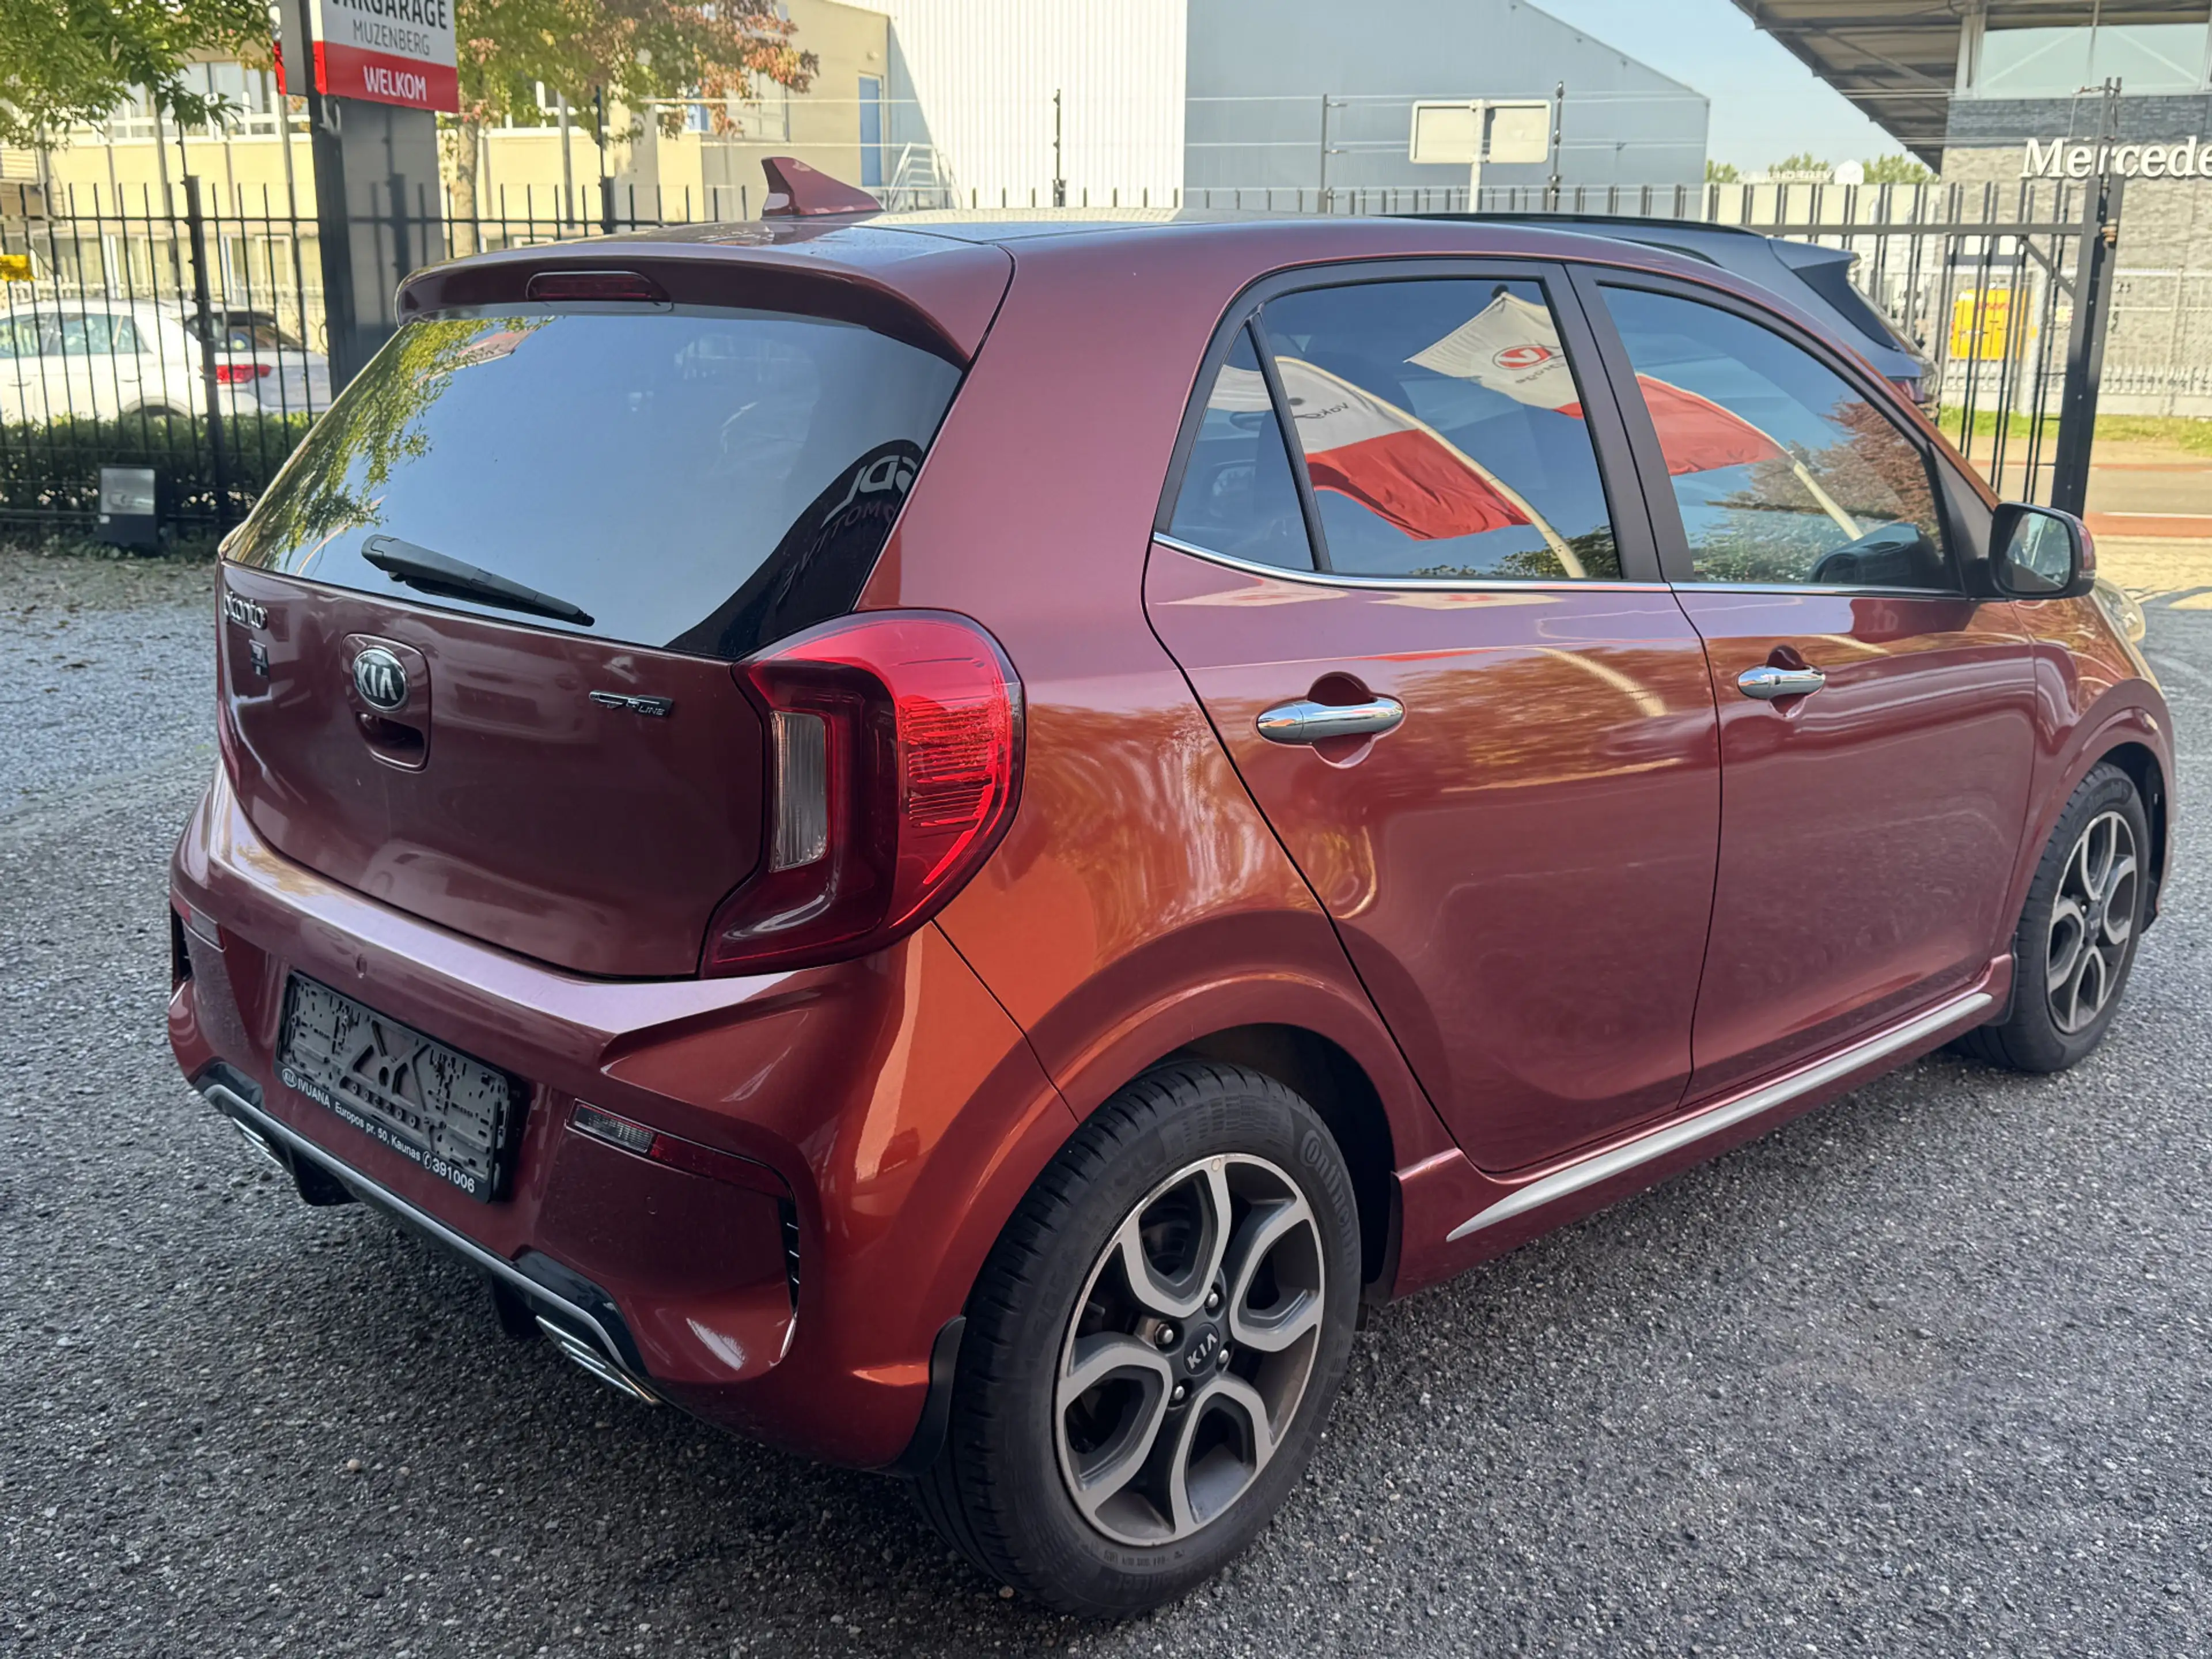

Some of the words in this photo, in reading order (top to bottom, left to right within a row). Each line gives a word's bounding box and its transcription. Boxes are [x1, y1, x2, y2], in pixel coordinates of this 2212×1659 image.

[353, 20, 430, 56] MUZENBERG
[363, 65, 427, 103] WELKOM
[356, 660, 399, 700] KIA
[298, 1078, 331, 1108] IVUANA
[335, 1101, 364, 1128] Europos
[366, 1123, 376, 1135] pr.
[378, 1128, 390, 1145] 50,
[392, 1135, 421, 1161] Kaunas
[433, 1158, 475, 1194] 391006
[1187, 1332, 1217, 1369] KIA
